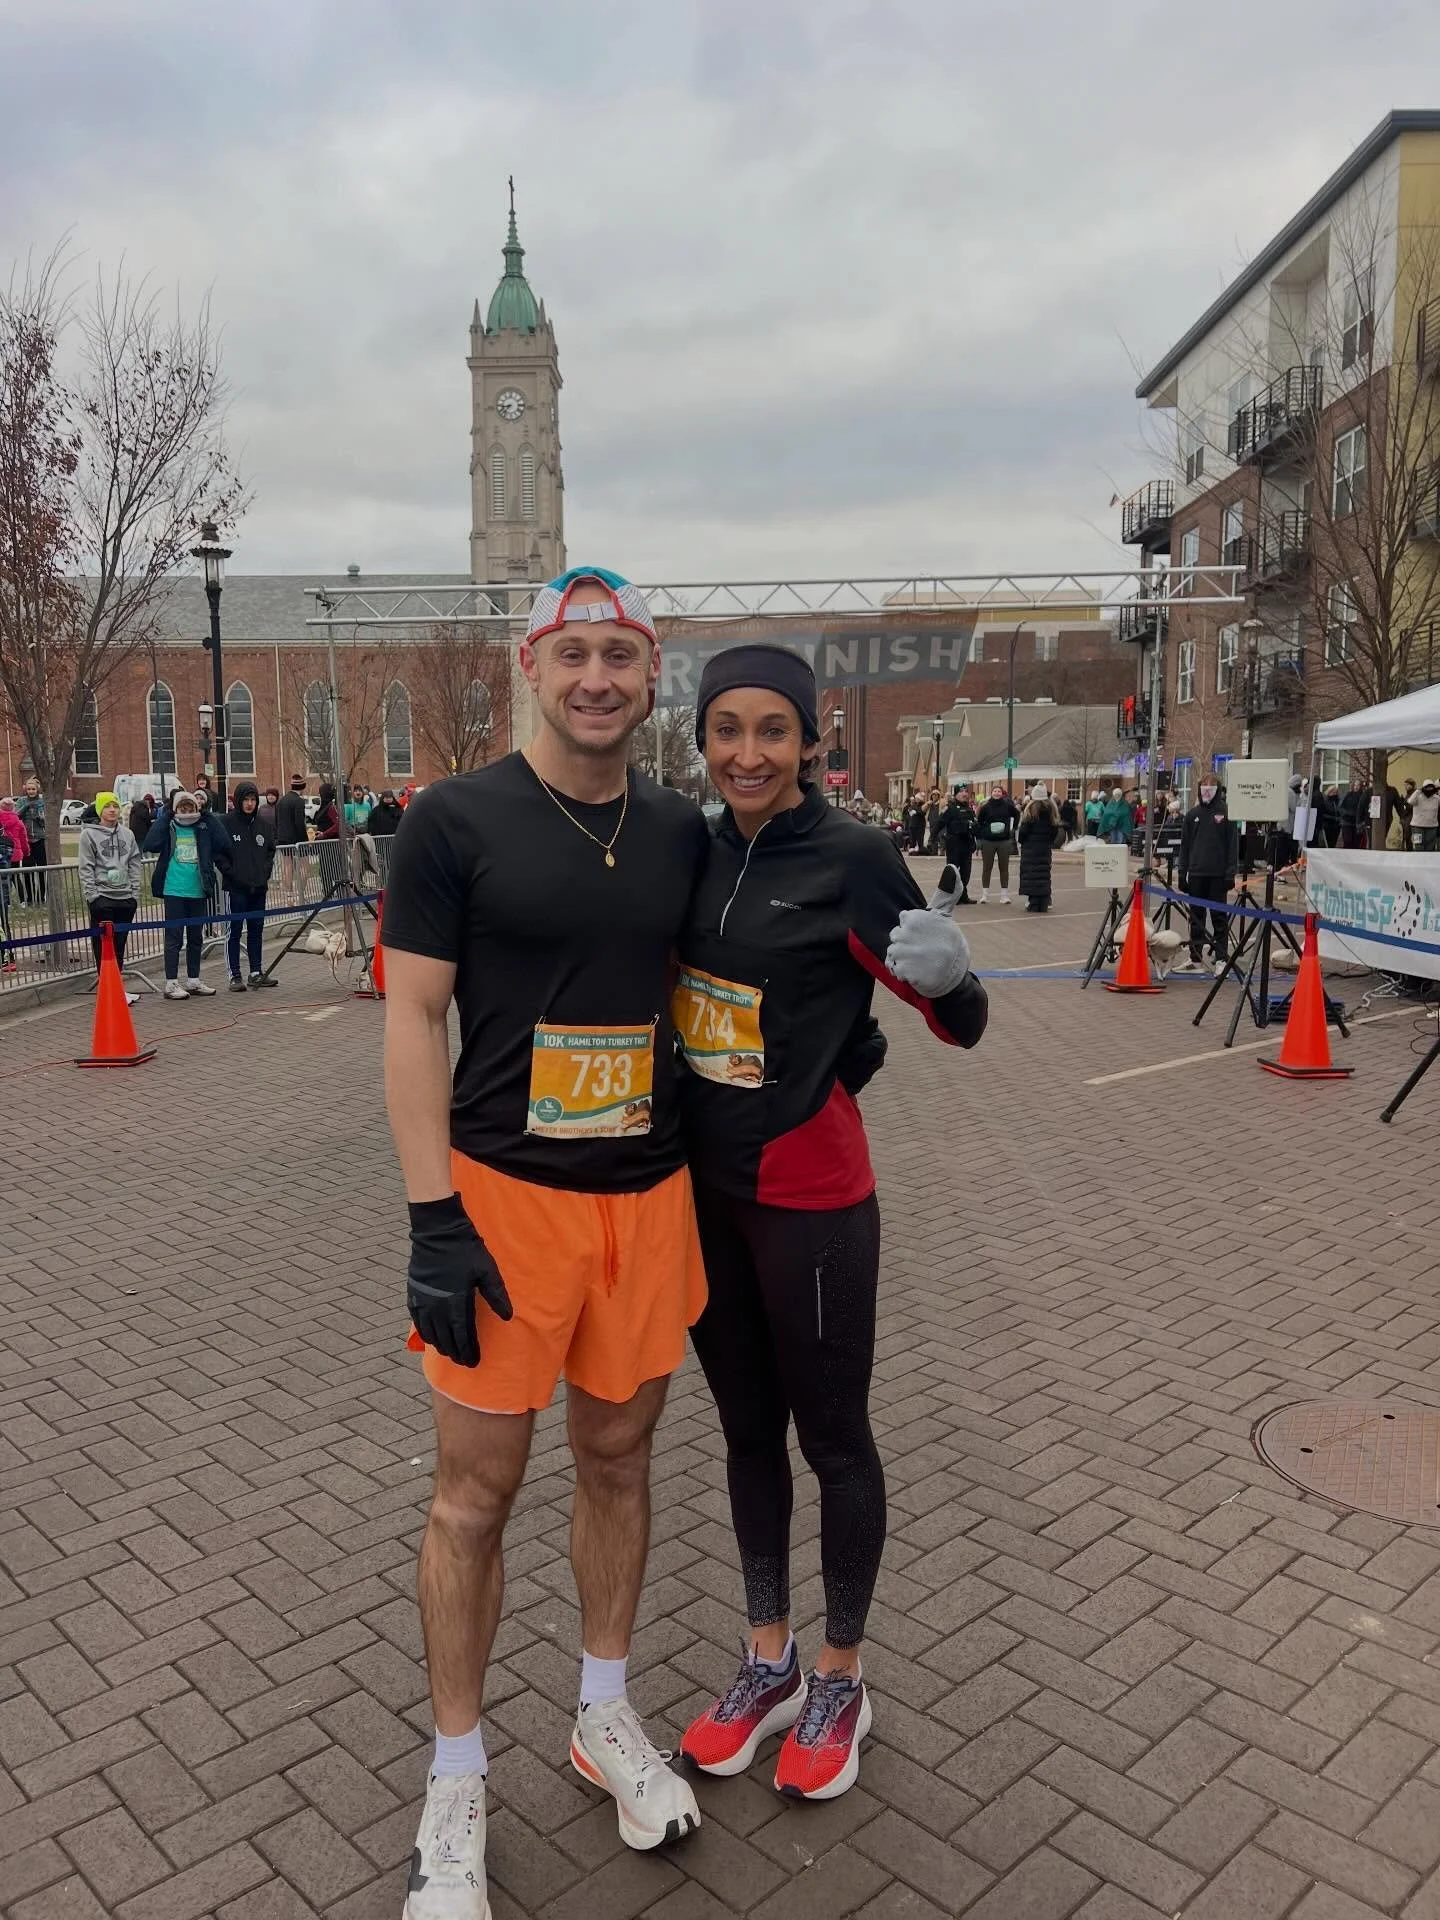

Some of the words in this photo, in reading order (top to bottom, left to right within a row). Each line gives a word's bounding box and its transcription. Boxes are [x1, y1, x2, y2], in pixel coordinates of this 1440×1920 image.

[232, 834, 241, 842] 14
[732, 993, 748, 1005] TROT
[688, 995, 737, 1047] 734
[543, 1034, 565, 1048] 10K
[568, 1036, 607, 1047] HAMILTON
[608, 1036, 634, 1046] TURKEY
[633, 1036, 649, 1046] TROT
[570, 1053, 633, 1098] 733
